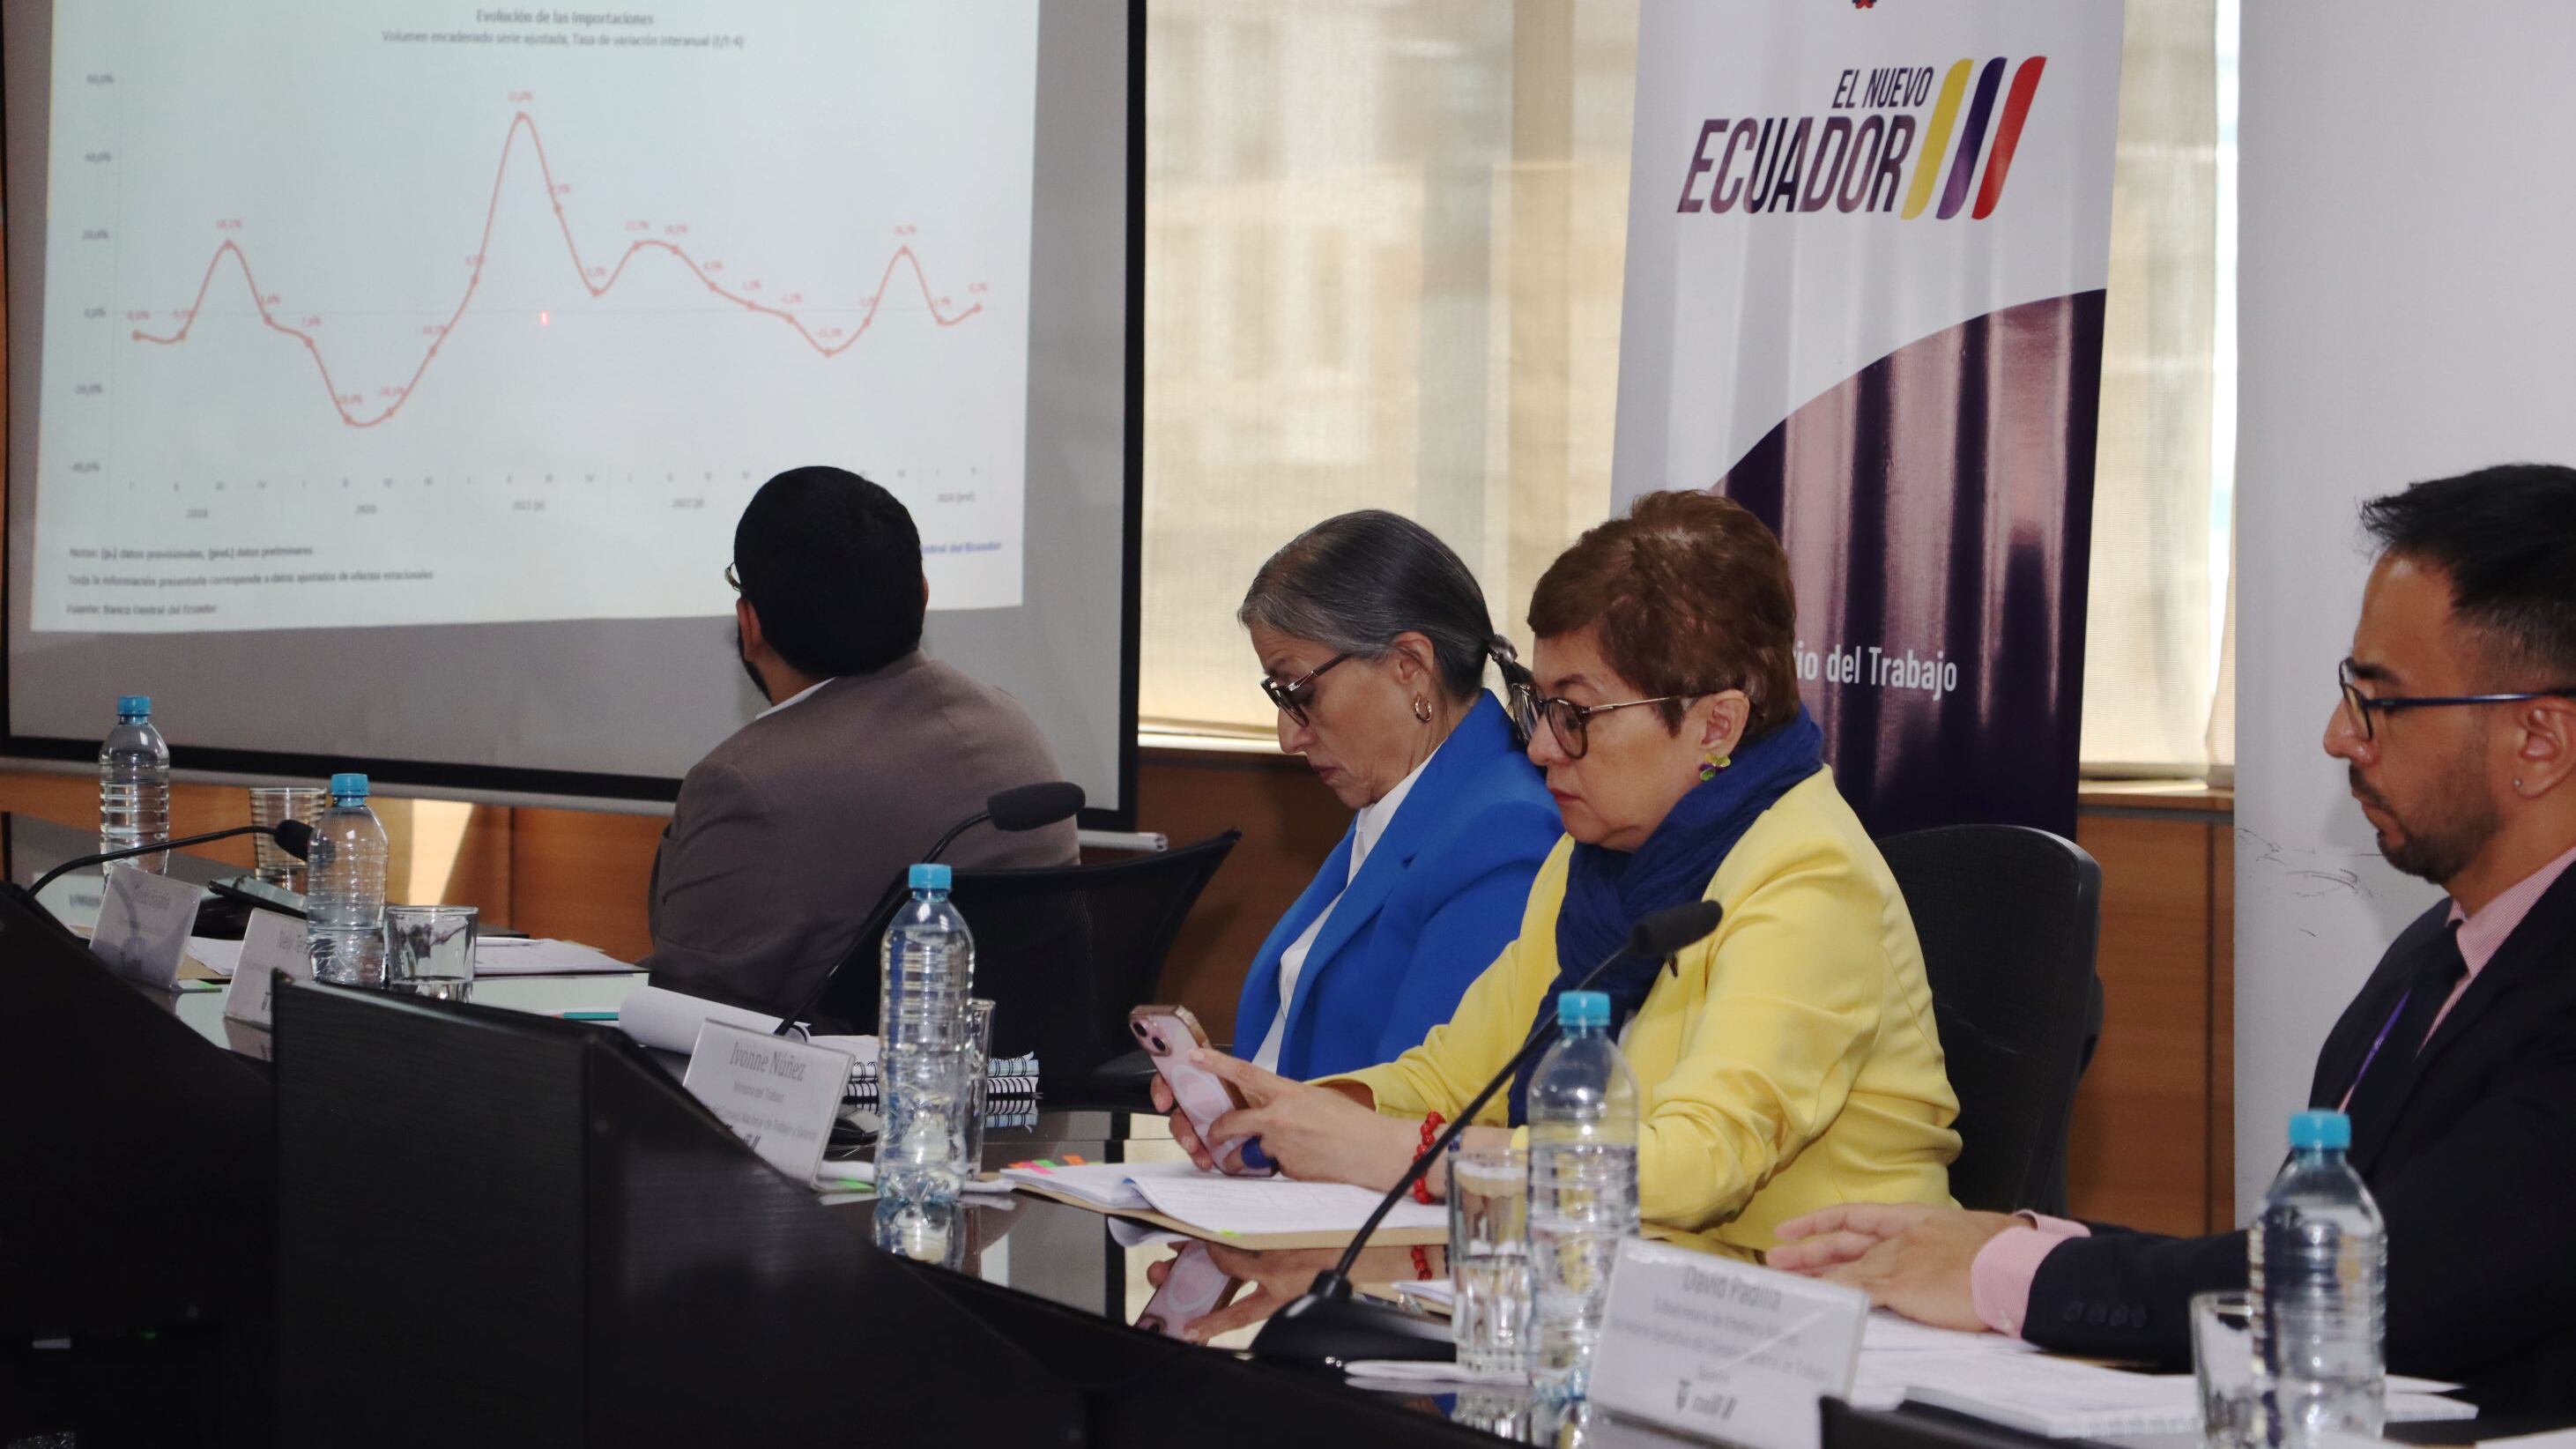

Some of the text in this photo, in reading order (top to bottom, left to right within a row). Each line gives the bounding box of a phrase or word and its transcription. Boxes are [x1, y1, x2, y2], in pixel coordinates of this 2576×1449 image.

[535, 9, 551, 23] de
[553, 9, 568, 24] las
[598, 33, 611, 45] de
[1832, 66, 1934, 108] EL NUEVO
[1676, 115, 1916, 214] ECUADOR
[1826, 645, 1860, 684] del
[1868, 646, 1957, 701] Trabajo
[730, 1042, 807, 1083] Ivonne Núñez
[1682, 1266, 1728, 1299] David
